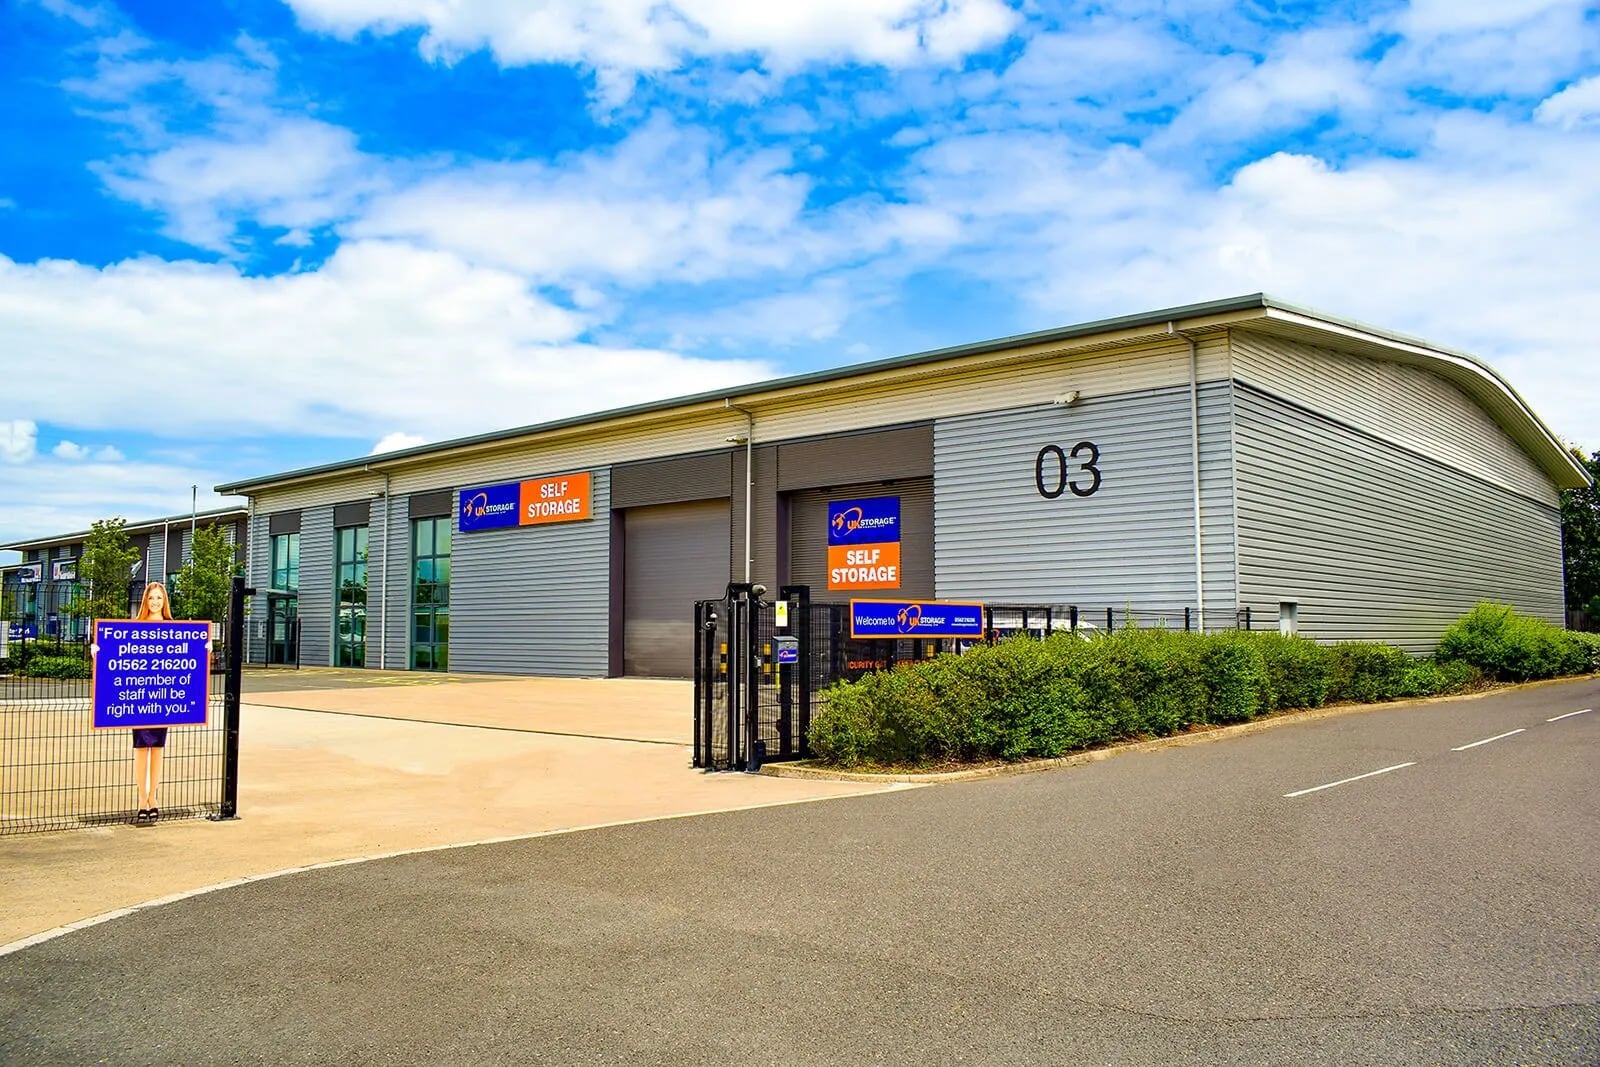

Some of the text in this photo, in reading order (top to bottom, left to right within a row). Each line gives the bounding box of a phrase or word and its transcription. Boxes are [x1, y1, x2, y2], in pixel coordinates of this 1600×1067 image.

[1036, 441, 1101, 499] 03
[541, 482, 568, 498] SELF
[486, 502, 514, 513] STORAGE
[528, 499, 580, 518] STORAGE
[860, 517, 894, 526] STORAGE
[847, 549, 880, 565] SELF
[832, 566, 897, 583] STORAGE
[855, 616, 895, 625] Welcome to
[909, 617, 919, 626] UK
[131, 628, 208, 640] assistance
[119, 642, 188, 656] please call
[108, 659, 197, 671] 01562 216200
[849, 661, 873, 669] CURITY
[114, 673, 192, 686] a member of
[118, 687, 186, 701] staff will be
[107, 703, 134, 718] right
[138, 702, 162, 714] with
